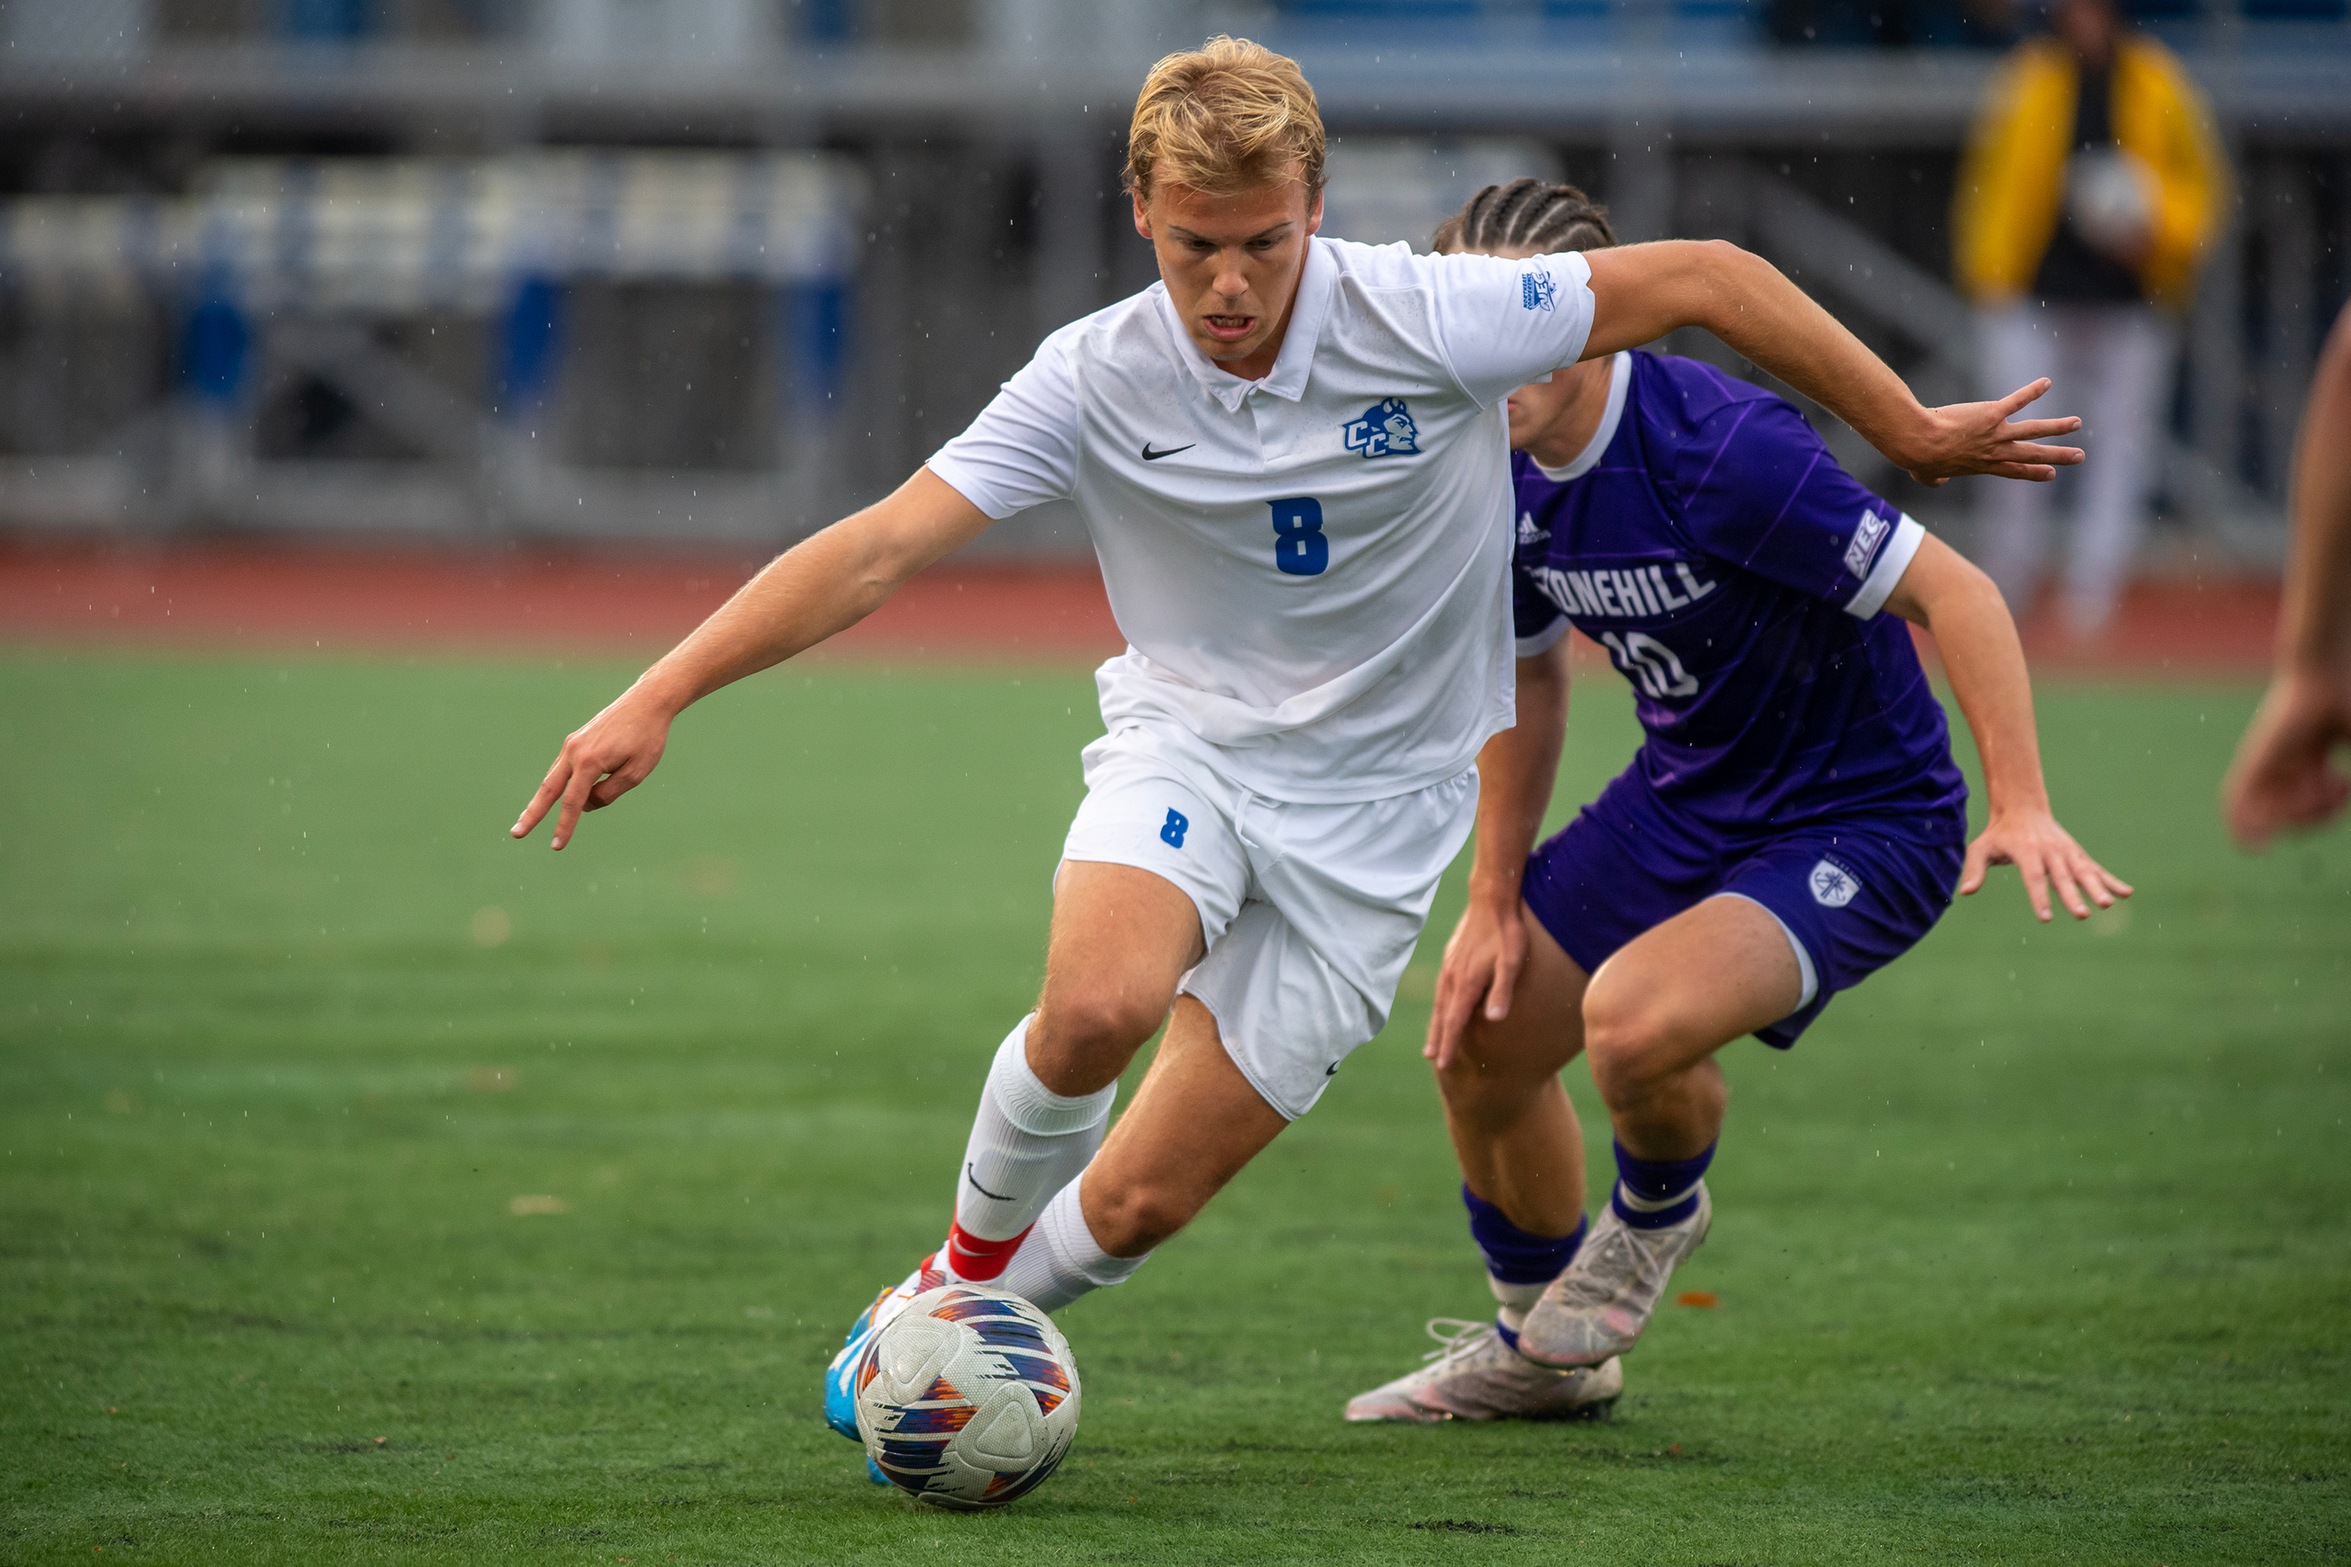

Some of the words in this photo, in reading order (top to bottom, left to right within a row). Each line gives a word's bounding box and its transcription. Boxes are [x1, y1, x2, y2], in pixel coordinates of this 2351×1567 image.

[1531, 271, 1551, 312] NEC
[1265, 496, 1329, 576] 8
[1845, 511, 1881, 578] NEC
[1601, 630, 1699, 699] 10
[1160, 806, 1189, 849] 8
